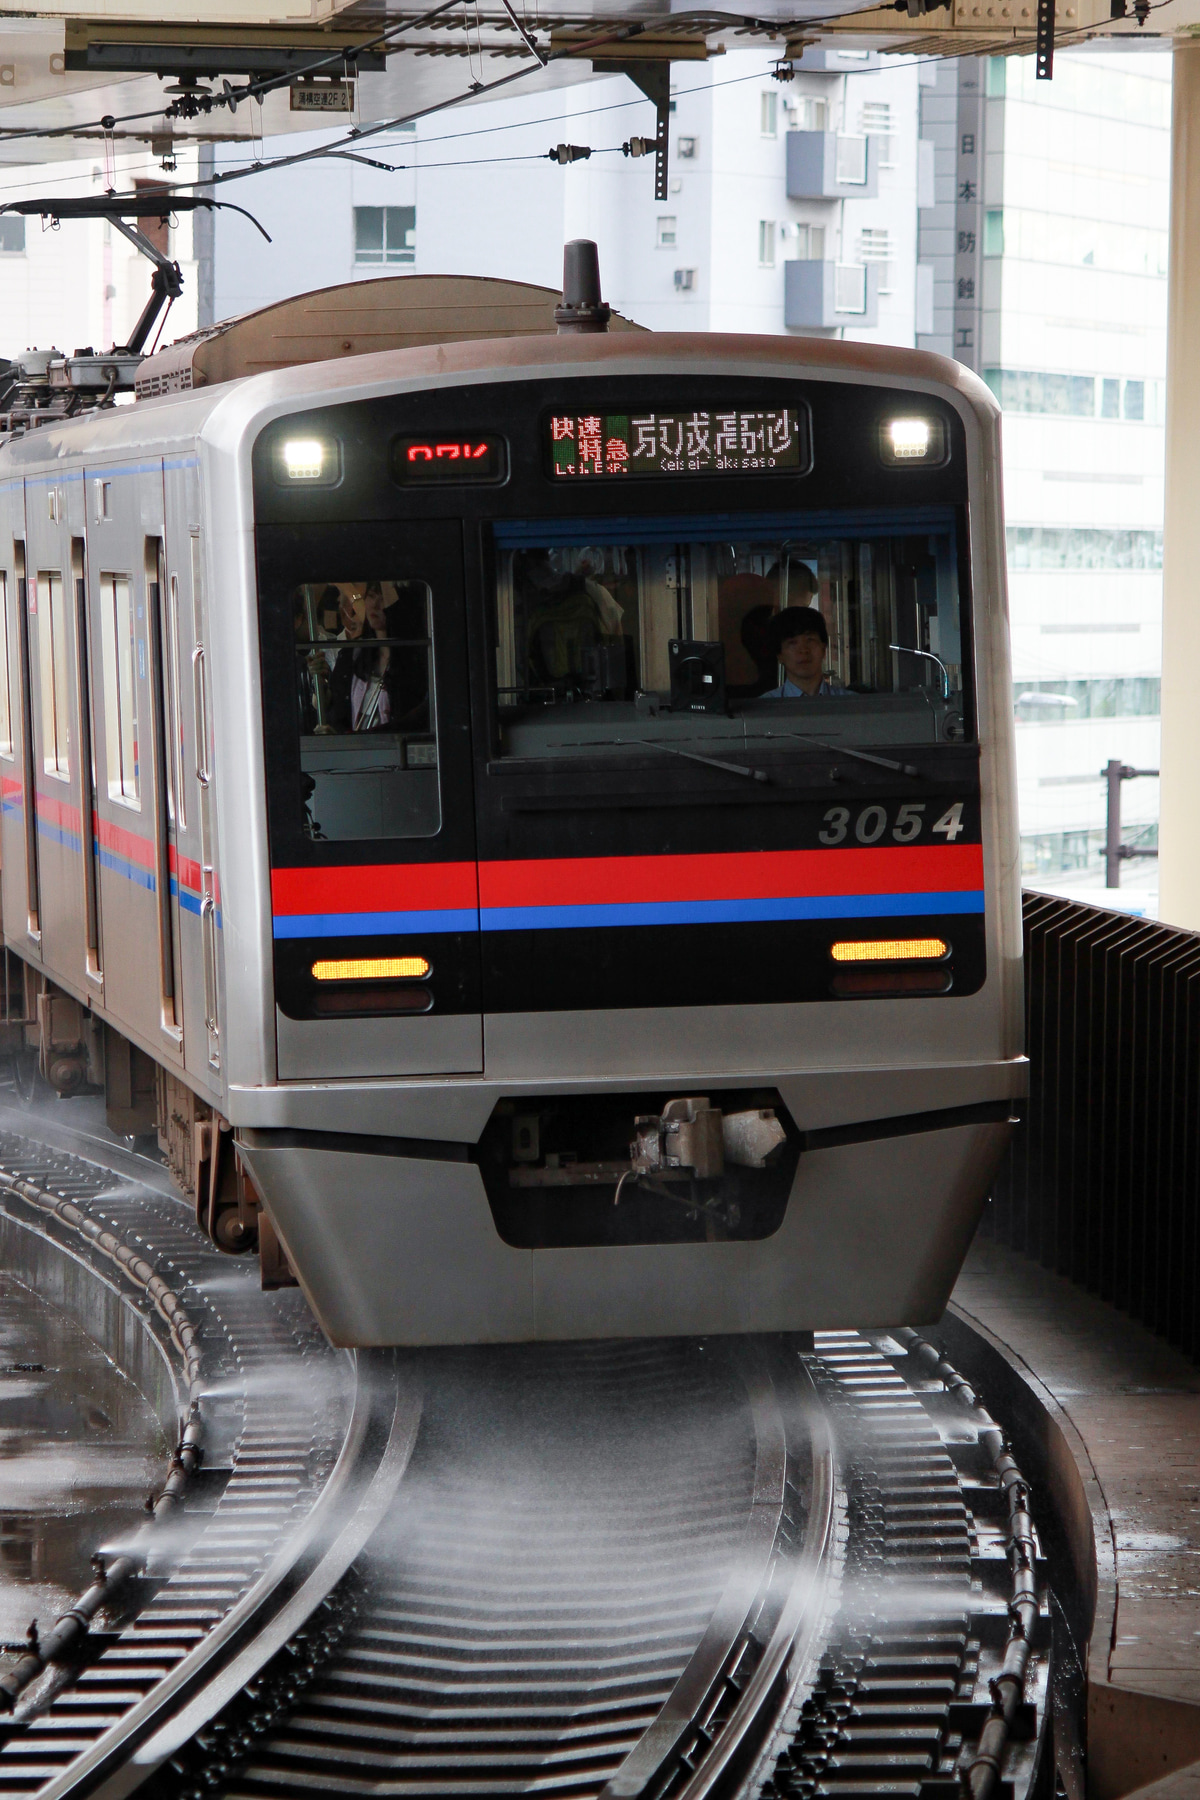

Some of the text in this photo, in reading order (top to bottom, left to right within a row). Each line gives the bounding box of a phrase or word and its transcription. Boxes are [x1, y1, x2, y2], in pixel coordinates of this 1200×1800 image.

[551, 415, 603, 440] 快速
[577, 437, 631, 462] 特急
[818, 803, 965, 845] 3054
